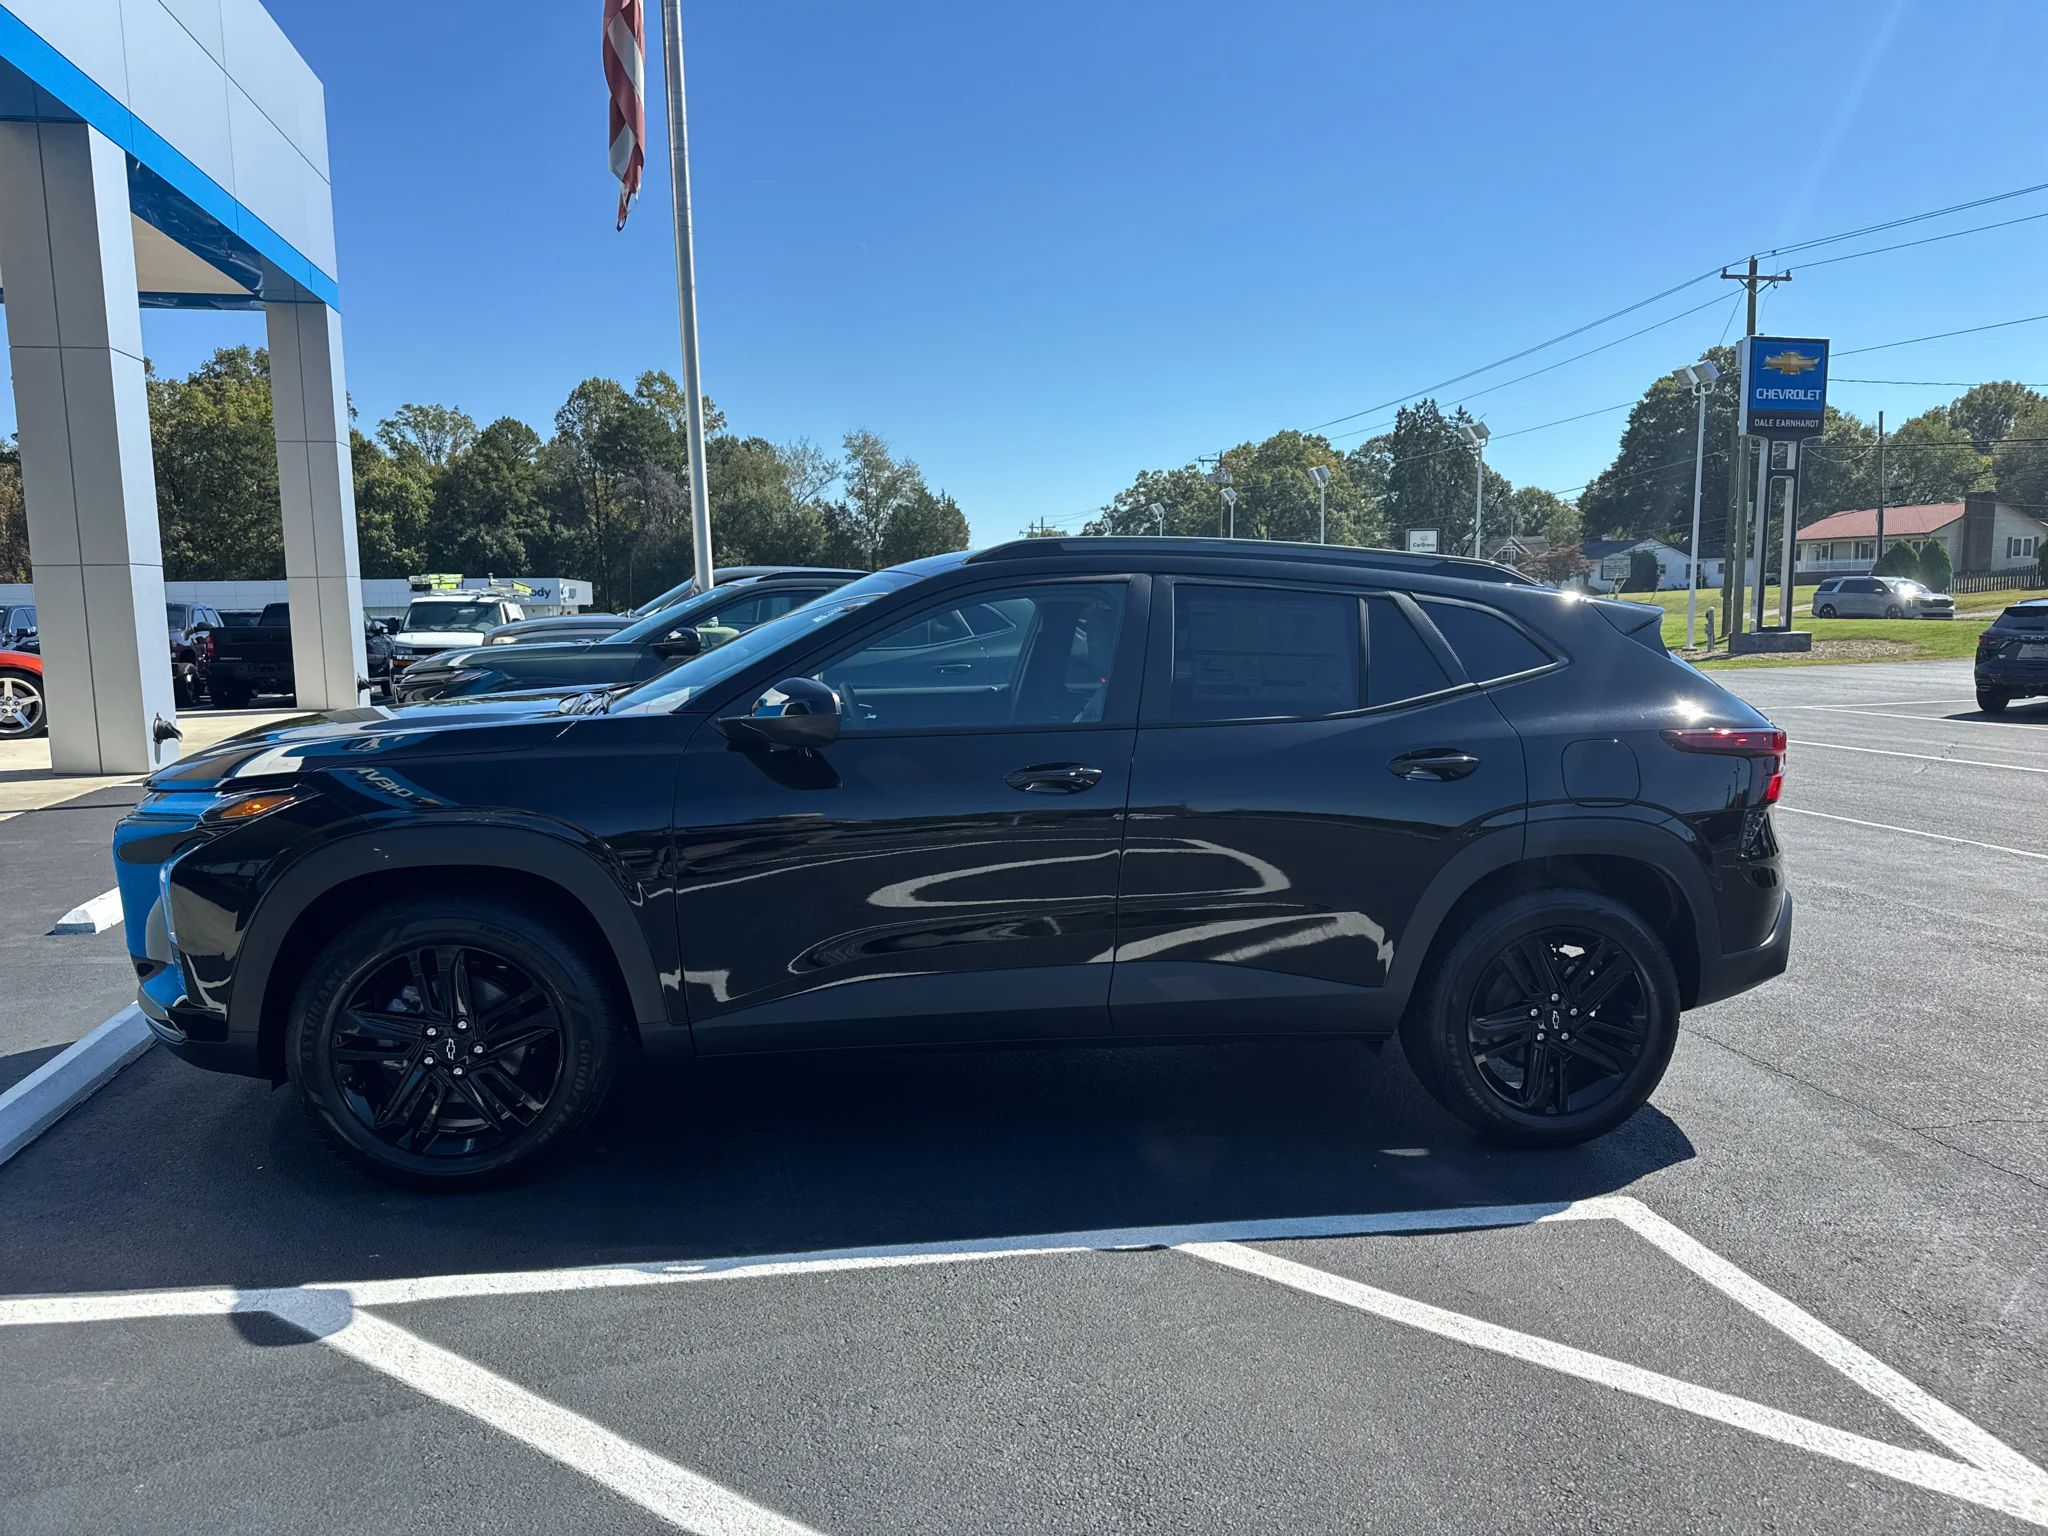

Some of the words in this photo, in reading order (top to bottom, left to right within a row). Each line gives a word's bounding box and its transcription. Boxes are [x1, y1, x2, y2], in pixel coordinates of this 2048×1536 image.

[1756, 388, 1821, 400] CHEVROLET
[1755, 419, 1774, 427] DALE
[1776, 419, 1819, 428] EARNHARDT
[531, 587, 551, 599] ody
